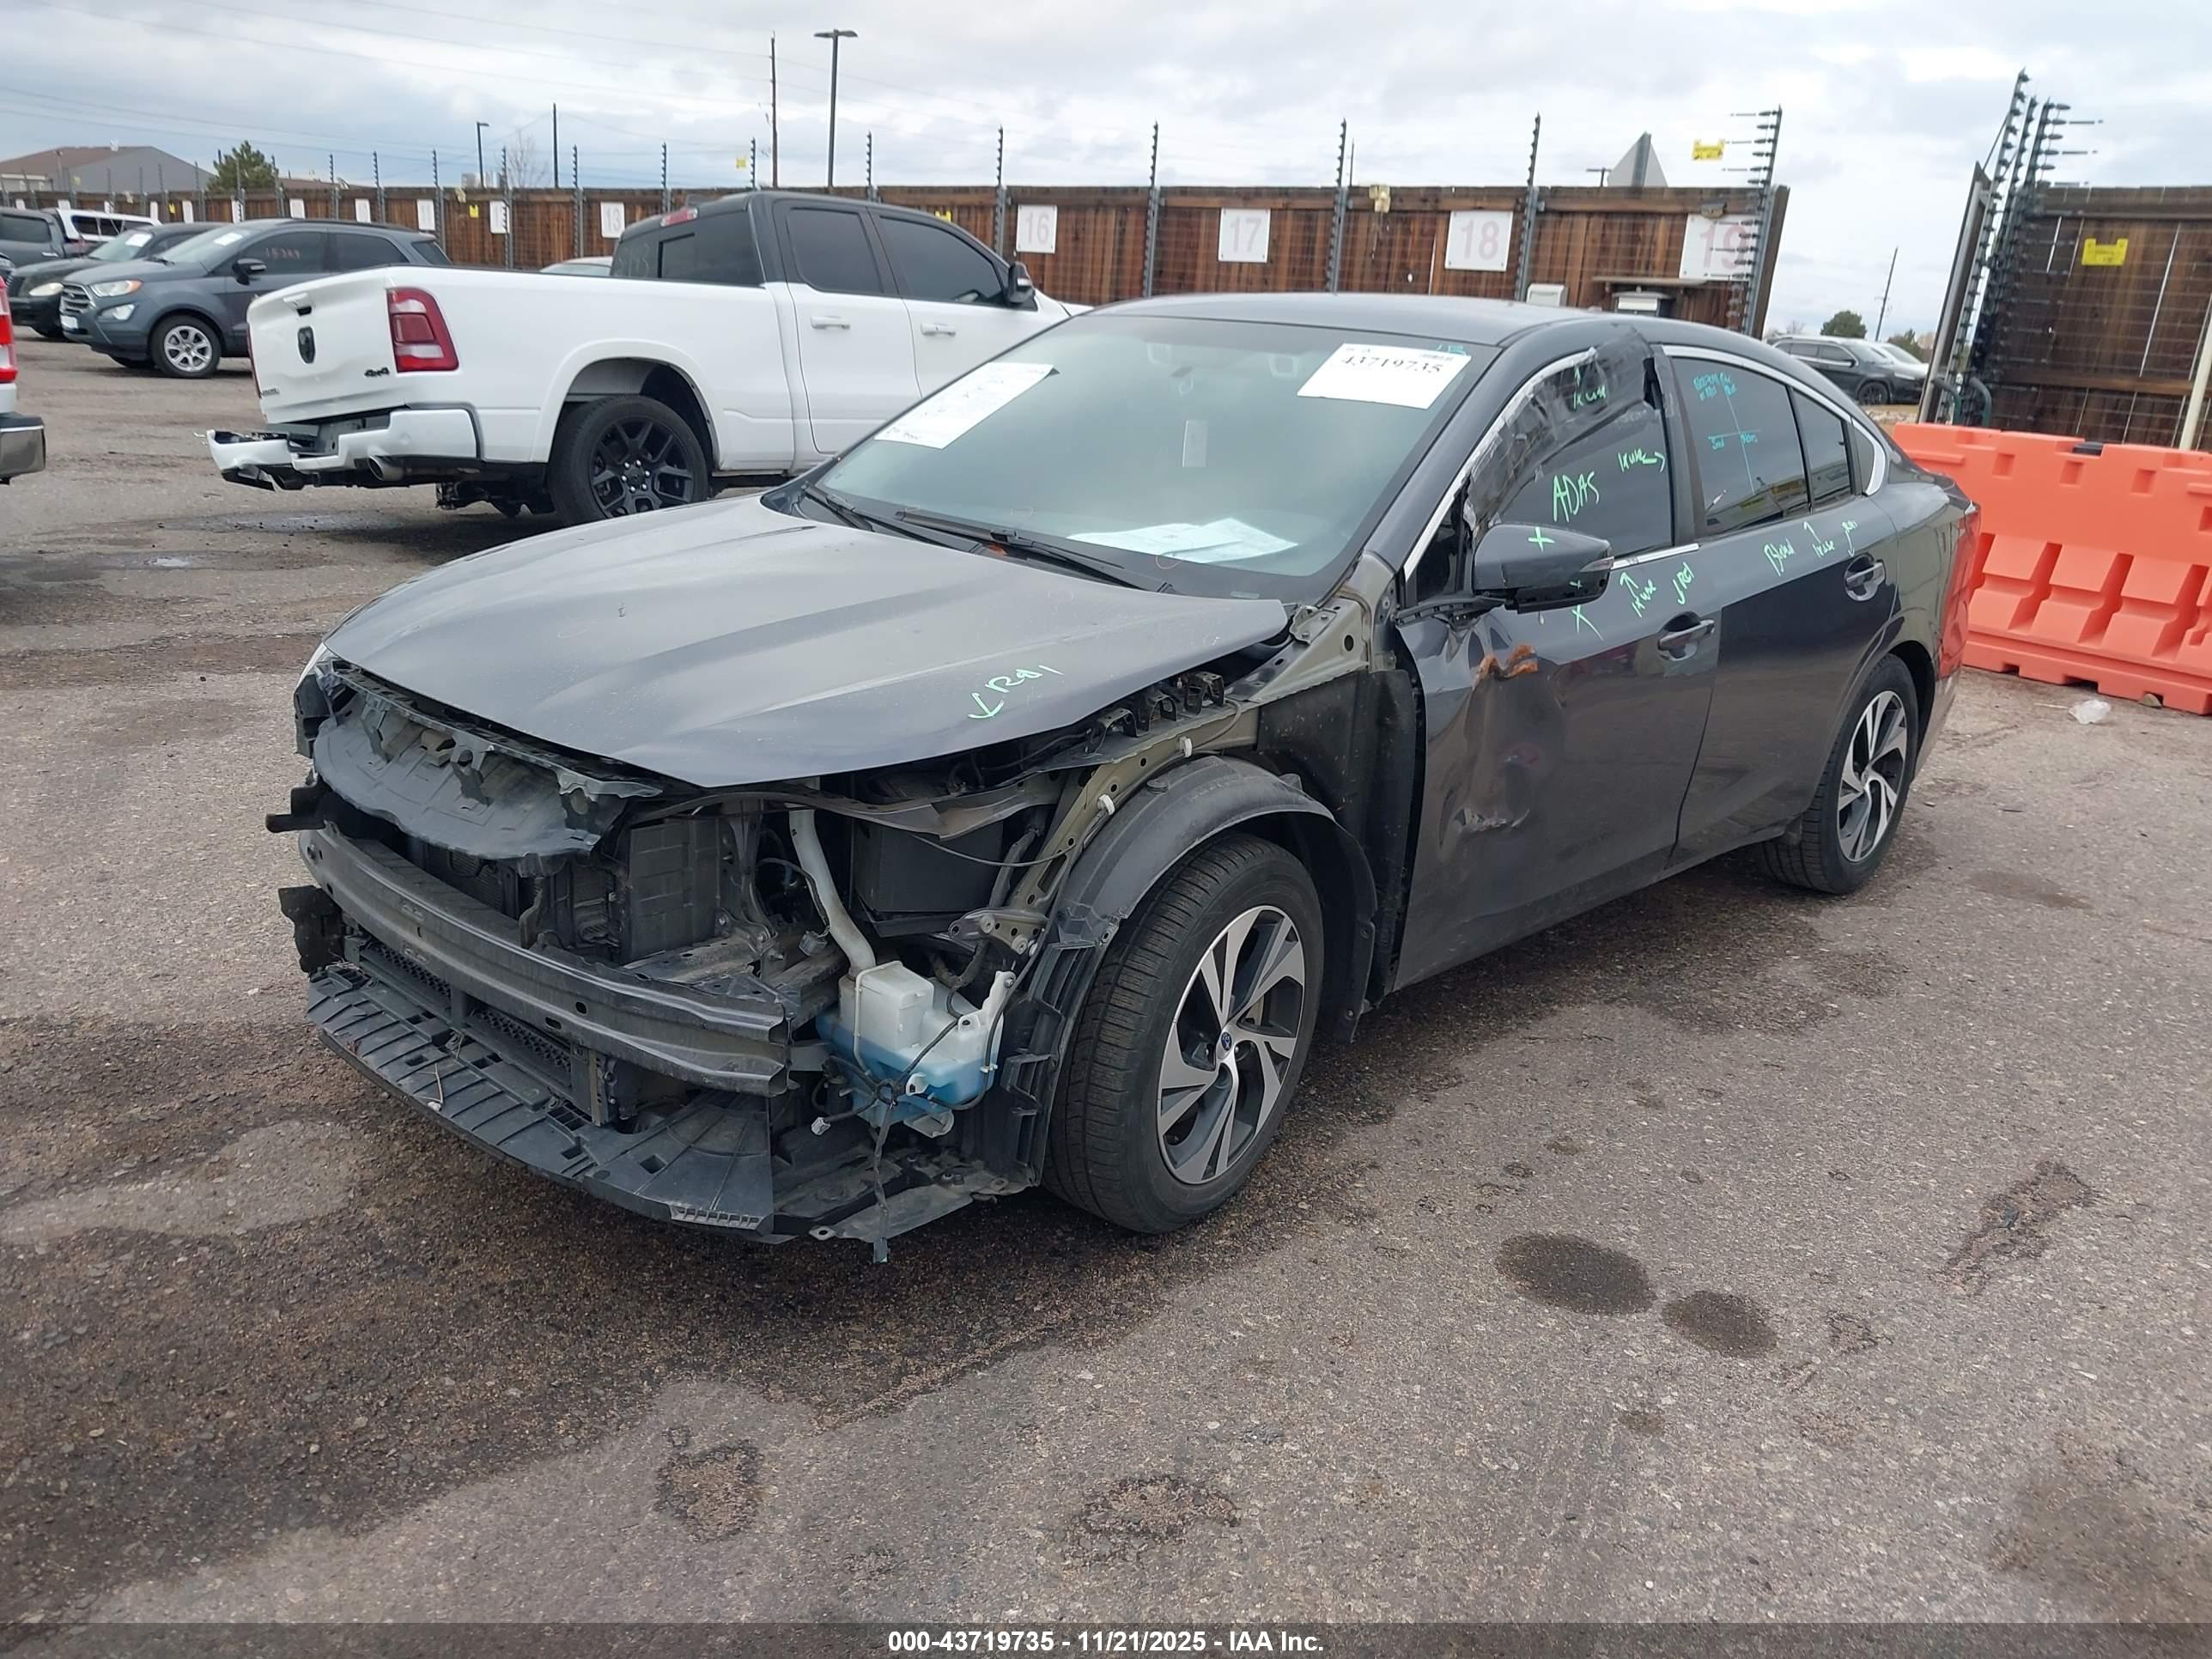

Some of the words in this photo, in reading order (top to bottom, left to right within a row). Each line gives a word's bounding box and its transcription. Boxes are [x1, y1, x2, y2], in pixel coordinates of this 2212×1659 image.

[605, 208, 621, 238] 13
[1025, 212, 1049, 246] 16
[1230, 216, 1261, 253] 17
[1461, 219, 1499, 261] 18
[1701, 221, 1749, 270] 19
[1341, 355, 1443, 374] 43719735
[1553, 471, 1600, 522] ADAS
